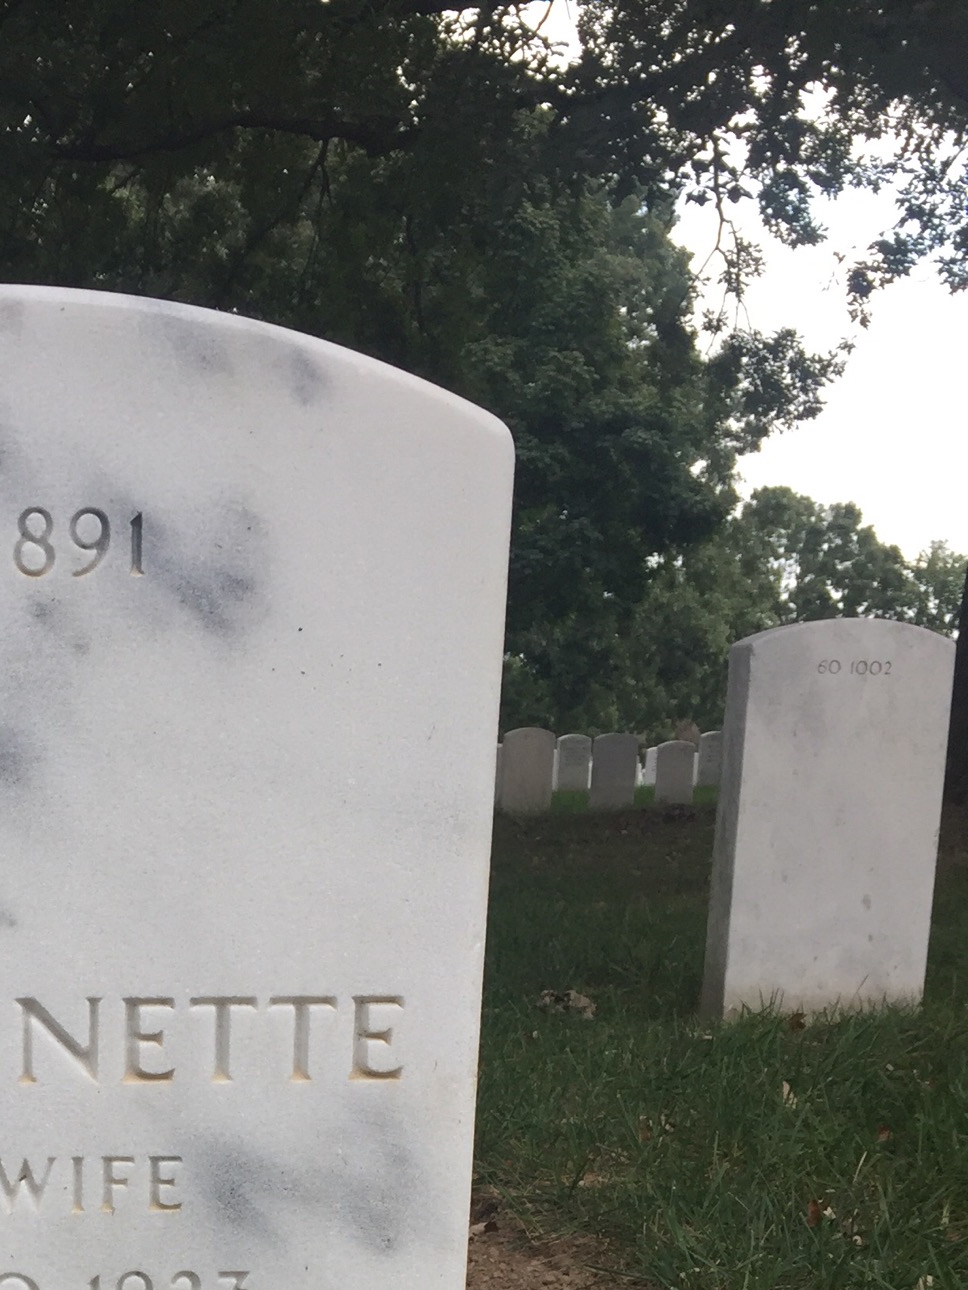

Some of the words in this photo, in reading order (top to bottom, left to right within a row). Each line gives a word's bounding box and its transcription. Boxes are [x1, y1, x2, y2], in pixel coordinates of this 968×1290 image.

[13, 505, 144, 577] 891
[817, 659, 842, 675] 60
[850, 660, 892, 676] 1002
